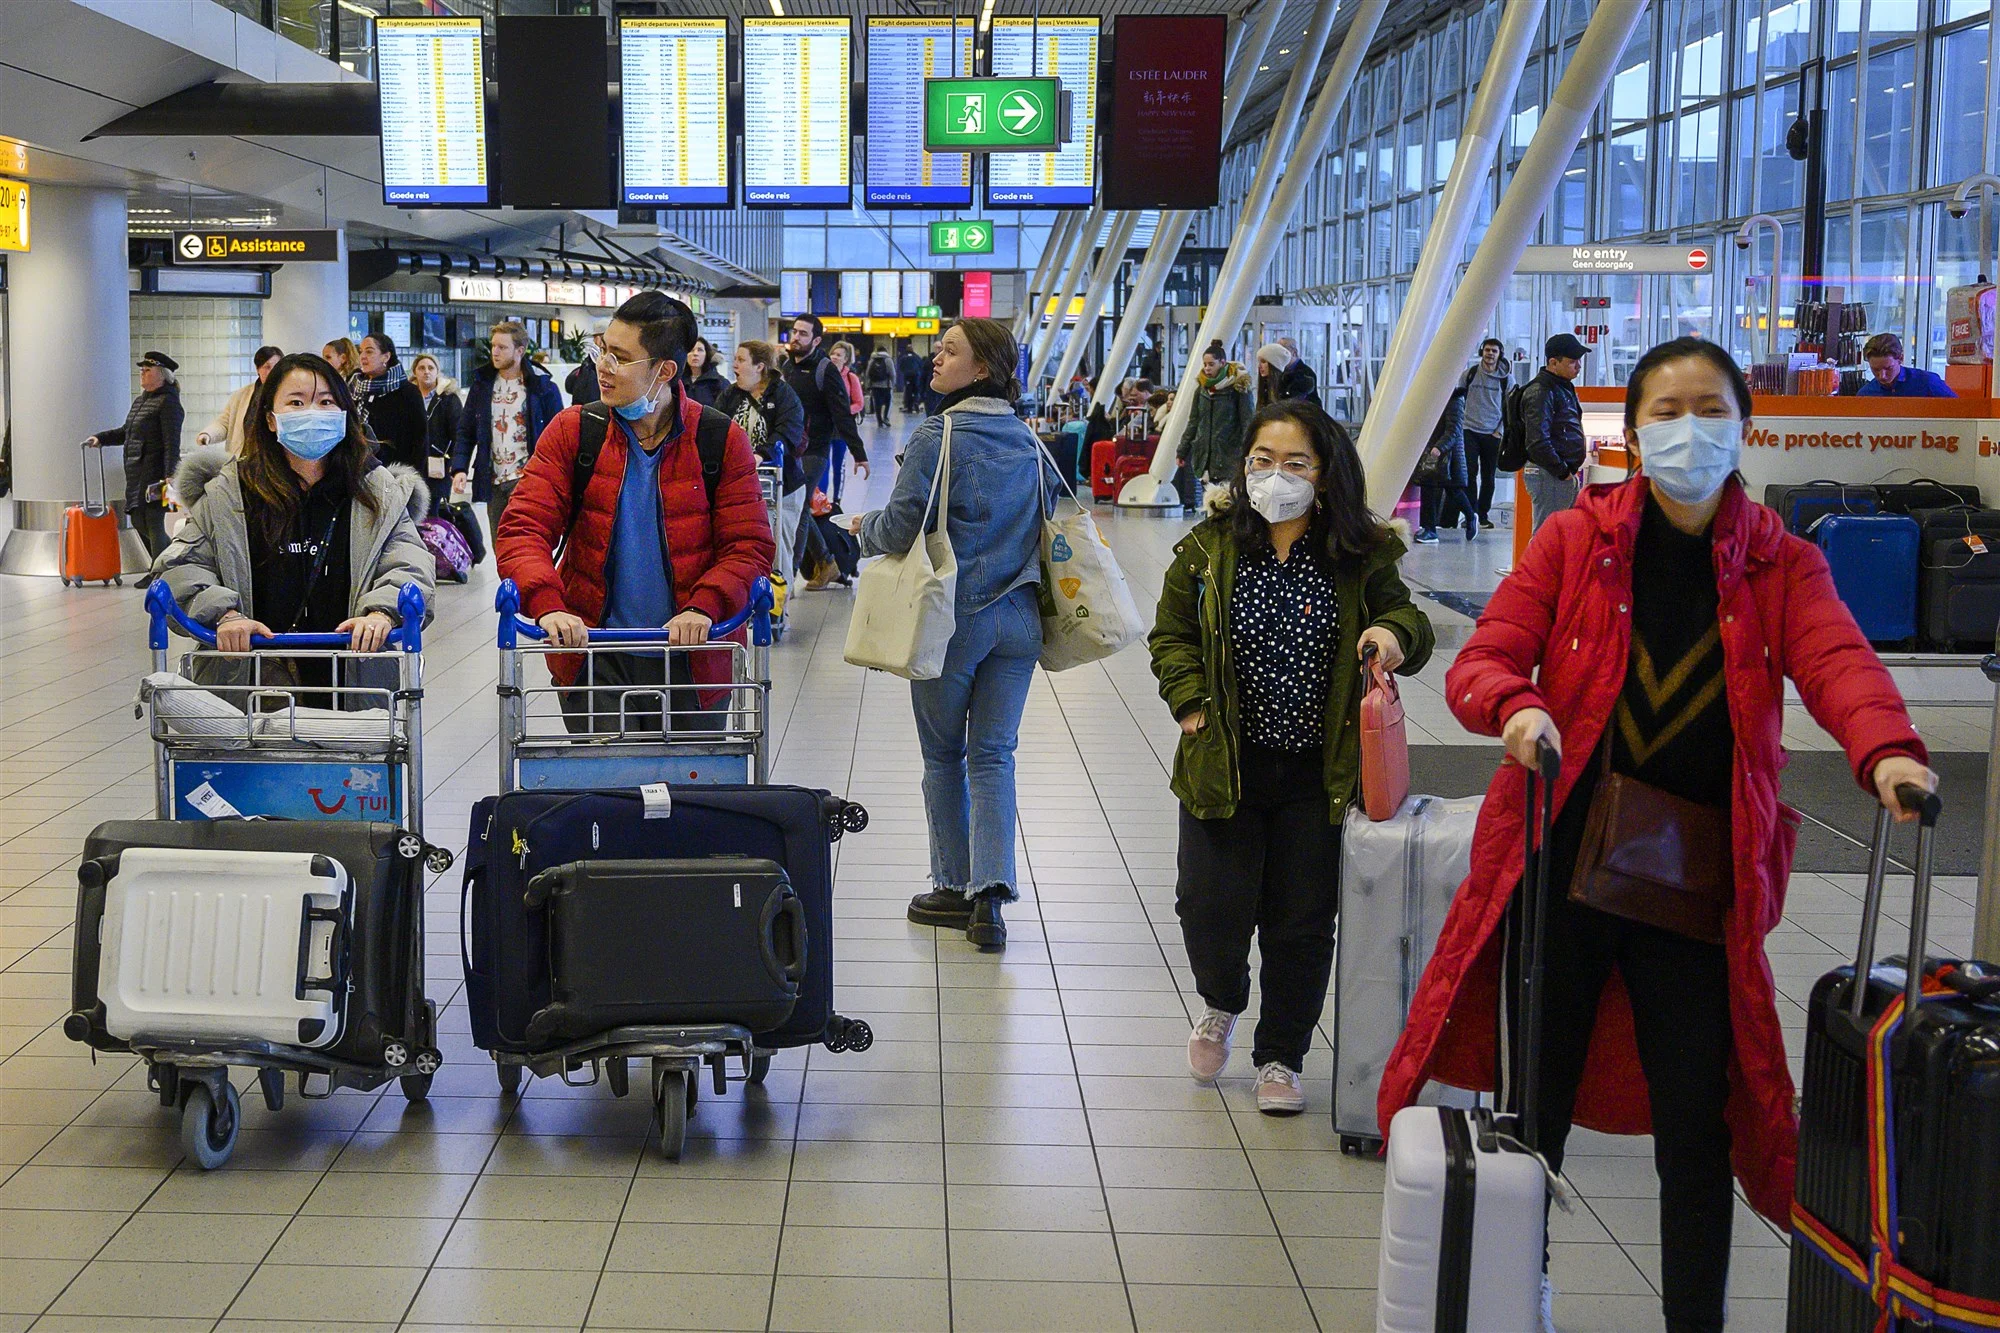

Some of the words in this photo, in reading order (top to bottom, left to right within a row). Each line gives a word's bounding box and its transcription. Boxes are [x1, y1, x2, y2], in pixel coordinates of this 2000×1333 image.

[1164, 70, 1208, 80] LAUDER
[230, 239, 306, 252] Assistance
[1573, 248, 1591, 259] No
[1594, 249, 1627, 261] entry
[1573, 261, 1593, 269] Geen
[1595, 260, 1633, 270] doorgang
[1747, 429, 1779, 447] We
[1785, 431, 1863, 451] protect
[1868, 435, 1916, 451] your
[1921, 431, 1959, 453] bag
[356, 796, 388, 811] TUI
